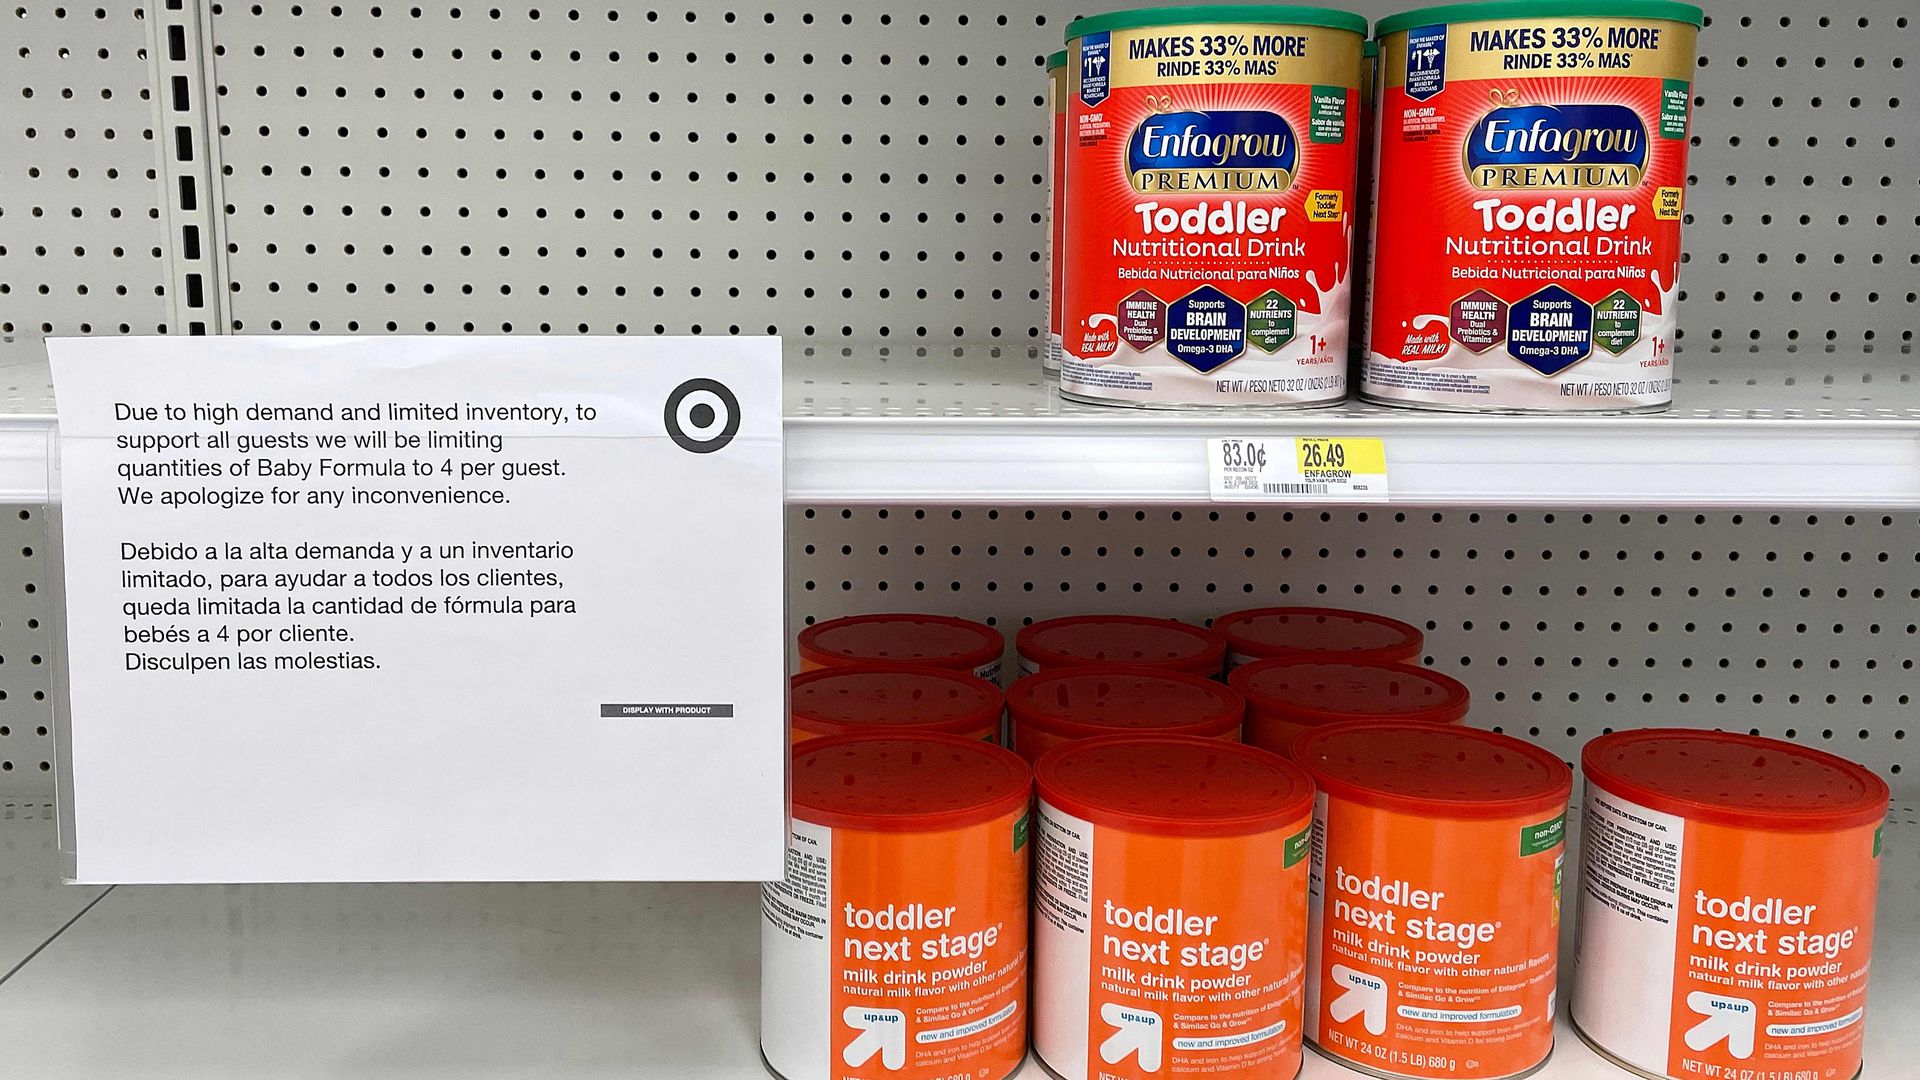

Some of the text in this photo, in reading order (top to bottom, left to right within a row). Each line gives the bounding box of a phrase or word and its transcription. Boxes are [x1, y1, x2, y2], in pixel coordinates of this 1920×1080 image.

[1129, 38, 1194, 59] MAKES
[1200, 36, 1248, 56] 33%
[1471, 30, 1546, 51] MAKES
[1552, 28, 1603, 49] 33%
[1157, 61, 1200, 77] RINDE
[1205, 61, 1240, 76] 33%
[1503, 54, 1552, 70] RINDE
[1557, 53, 1594, 68] 33%
[1143, 124, 1285, 166] Enfagrow
[1484, 120, 1638, 161] Enfagrow
[1141, 172, 1281, 191] PREMIUM
[1482, 169, 1629, 186] PREMIUM
[1134, 200, 1287, 235] Toddler
[1473, 197, 1636, 234] Toddler
[1113, 238, 1305, 257] Nutritional Drink
[1446, 236, 1651, 256] Nutritional Drink
[1118, 267, 1299, 282] Bebida Nutricional para Niños
[1452, 266, 1645, 281] Bebida Nutricional para Niños
[1126, 301, 1157, 310] IMMUNE
[1188, 300, 1225, 309] Supports
[1266, 300, 1278, 308] 22
[1460, 301, 1498, 311] IMMUNE
[1533, 300, 1571, 310] Supports
[1613, 300, 1625, 309] 22
[1127, 311, 1155, 319] HEALTH
[1187, 313, 1226, 326] BRAIN
[1250, 310, 1291, 319] NUTRIENTS
[1462, 311, 1495, 320] HEALTH
[1470, 320, 1485, 328] Dual
[1530, 313, 1573, 328] BRAIN
[1597, 310, 1638, 319] NUTRIENTS
[1170, 329, 1242, 341] DEVELOPMENT
[1457, 327, 1490, 335] Prebiotics
[1462, 335, 1492, 343] Vitamins
[1512, 330, 1588, 342] DEVELOPMENT
[1598, 329, 1635, 337] complement
[1178, 344, 1233, 354] Omega-3 DHA
[1310, 335, 1326, 354] 1+
[1519, 345, 1579, 356] Omega-3 DHA
[1611, 337, 1622, 345] diet
[1296, 357, 1333, 365] YEARS/AÑOS
[114, 402, 597, 426] Due to high demand and limited inventory, to
[116, 430, 503, 454] support all guests we will be limiting
[1223, 443, 1266, 472] 83.0¢
[1303, 444, 1344, 467] 26.49
[117, 458, 566, 482] quantities of Baby Formula to 4 per guest.
[1305, 470, 1351, 478] ENFAGROW
[117, 485, 510, 510] We apologize for any inconvenience.
[121, 540, 574, 564] Debido a la alta demanda y a un inventario
[121, 568, 563, 592] limitado, para ayudar a todos los clientes,
[122, 595, 577, 620] queda limitada la cantidad de fórmula para
[124, 624, 354, 647] bebés a 4 por cliente.
[125, 651, 381, 675] Disculpen las molestias.
[1335, 866, 1444, 911] toddler
[844, 903, 956, 930] toddler
[1334, 898, 1395, 935] next
[1694, 889, 1816, 925] toddler
[1104, 900, 1218, 936] toddler
[1333, 928, 1480, 965] milk drink powder
[1692, 922, 1767, 954] next
[844, 936, 911, 962] next
[1103, 934, 1170, 966] next
[843, 959, 988, 985] milk drink powder
[1689, 954, 1842, 980] milk drink powder
[1102, 965, 1251, 992] milk drink powder
[1349, 974, 1381, 990] up&up
[1711, 1000, 1749, 1013] up&up
[864, 1013, 898, 1023] up&up
[1121, 1012, 1155, 1025] up&up
